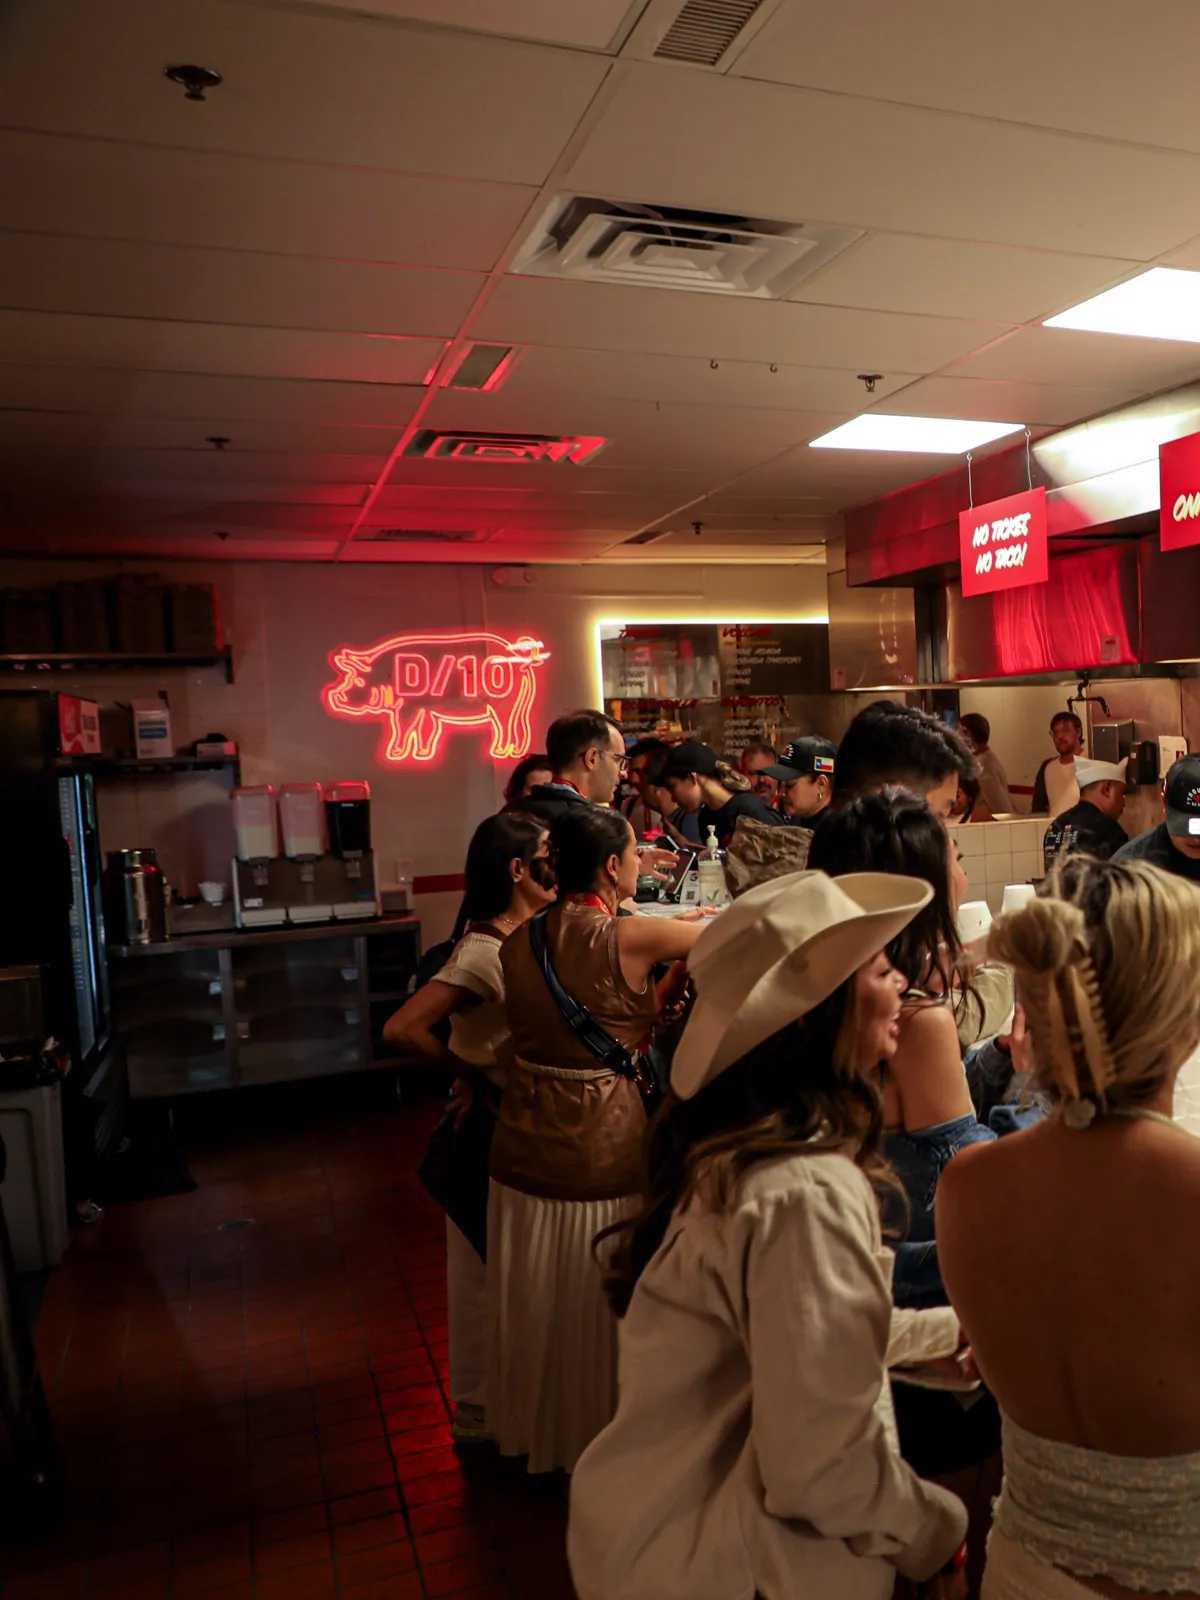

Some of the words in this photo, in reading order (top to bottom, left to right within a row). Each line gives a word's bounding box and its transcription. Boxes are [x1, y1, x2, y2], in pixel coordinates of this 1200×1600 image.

[972, 523, 990, 549] NO
[975, 550, 993, 575] NO
[994, 541, 1028, 570] TACO!
[395, 653, 514, 698] D/10
